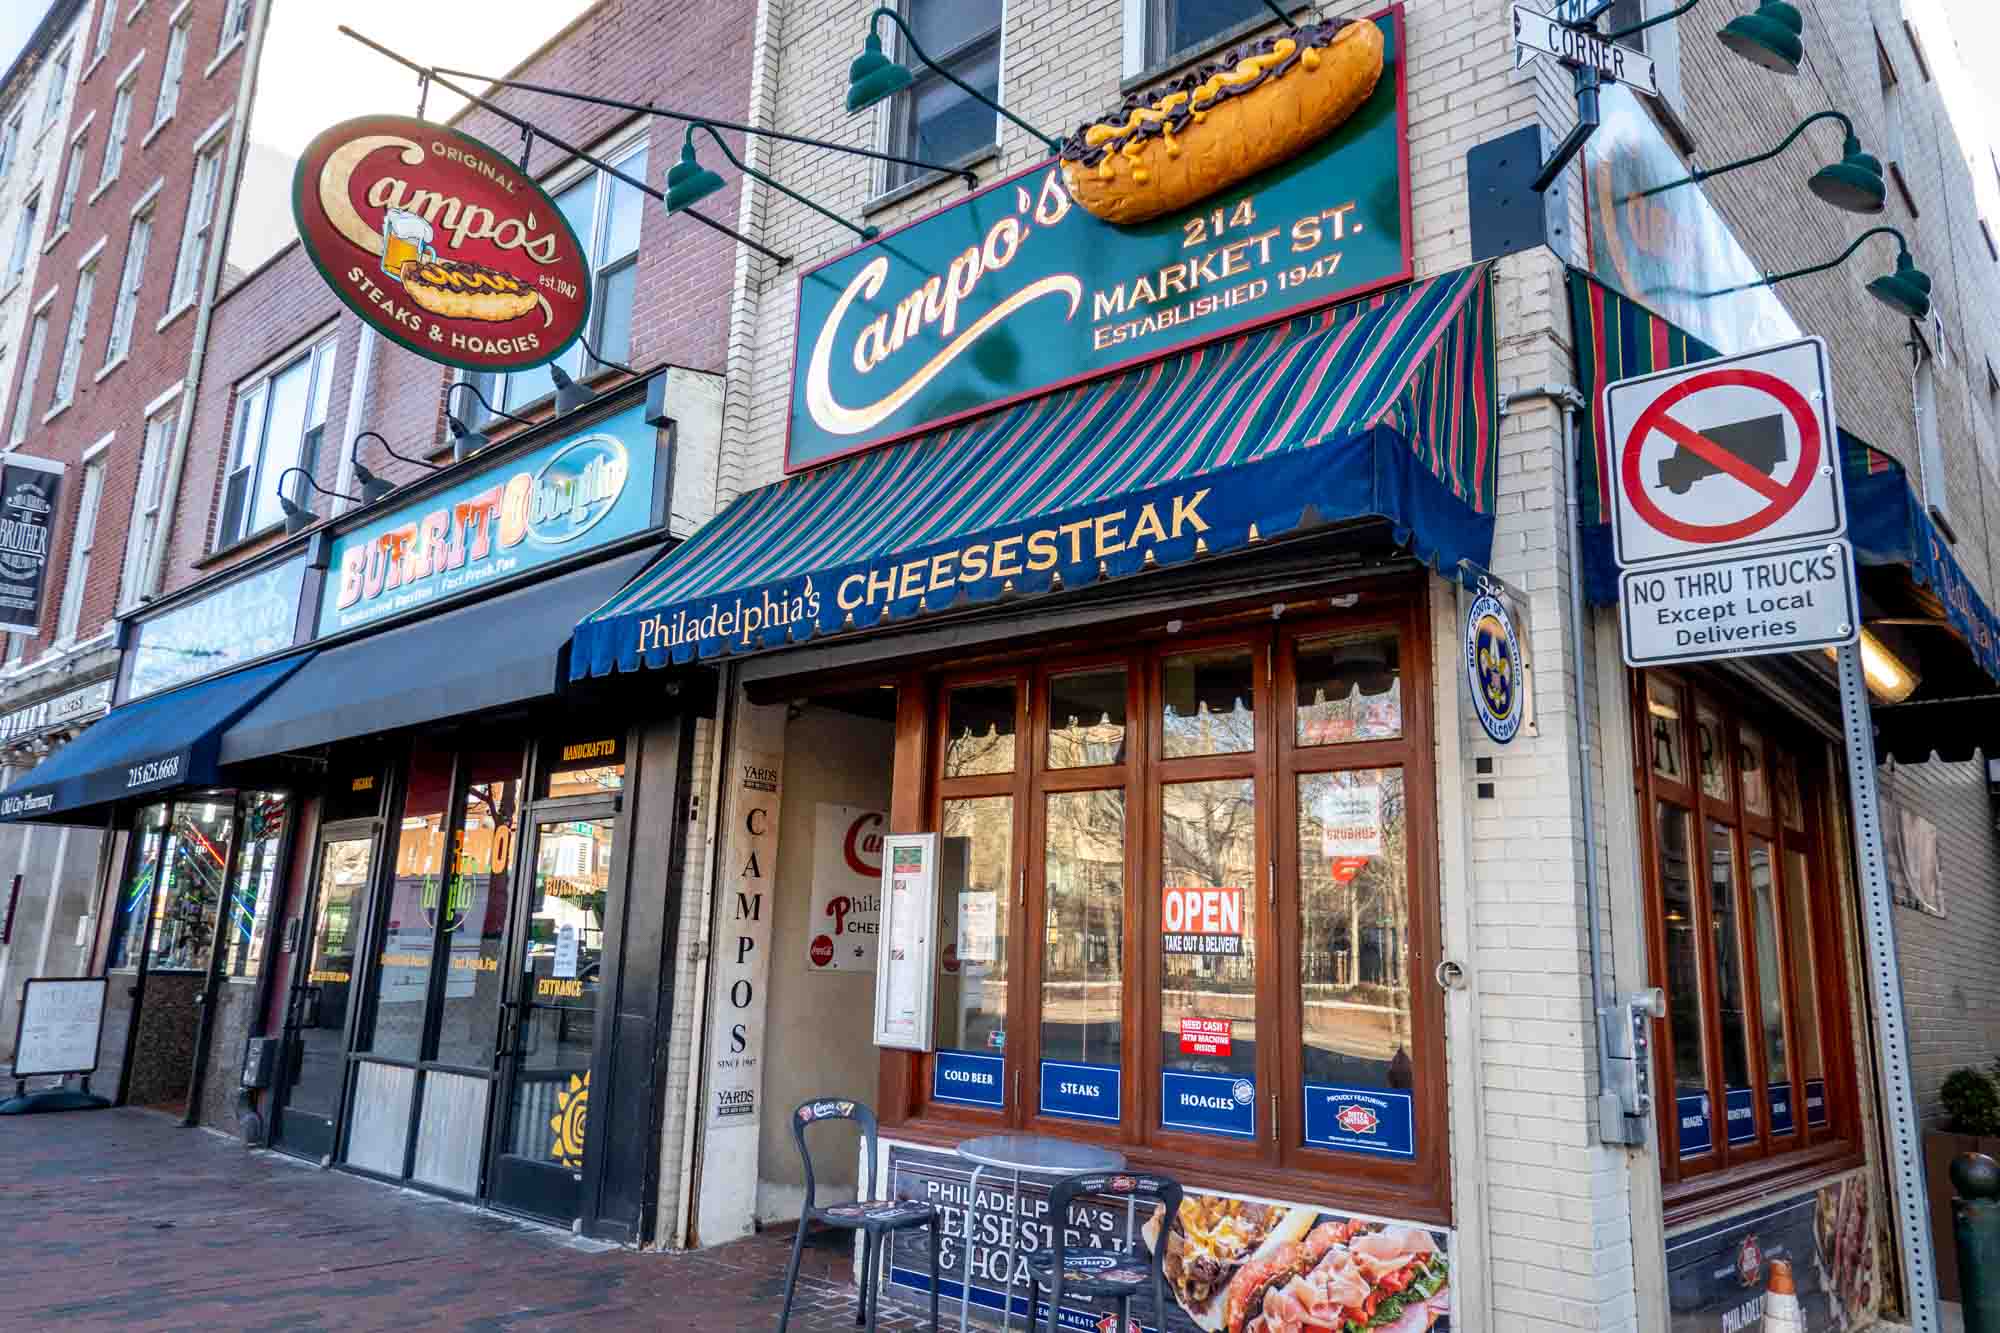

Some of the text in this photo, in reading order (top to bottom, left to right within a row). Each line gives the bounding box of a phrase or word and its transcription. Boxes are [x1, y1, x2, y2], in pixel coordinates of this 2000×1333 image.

[1548, 23, 1625, 79] CORNER
[431, 142, 516, 194] ORIGINAL
[318, 135, 563, 264] Campo's
[1183, 197, 1256, 249] 214
[1092, 201, 1365, 321] MARKET ST.
[348, 266, 539, 355] STEAKS & HOAGIES
[806, 169, 1072, 435] Campo's
[1093, 254, 1343, 350] ESTABLISHED 1947
[0, 518, 47, 554] BROTHER
[636, 487, 1213, 654] Philadelphia's CHEESESTEAK
[1633, 555, 1837, 605] NO THRU TRUCKS
[1471, 599, 1491, 631] SCOUTS
[1657, 590, 1814, 625] Except Local
[1676, 620, 1797, 646] Deliveries
[1482, 706, 1518, 738] WELCOME
[563, 738, 616, 761] HANDCRAFTED
[127, 755, 180, 788] 215.625.6668
[744, 766, 777, 782] YARDS
[1165, 890, 1240, 932] OPEN
[1165, 935, 1239, 953] TAKE OUT & DELIVERY
[538, 979, 584, 997] ENTRANCE
[1183, 1020, 1201, 1030] NEED
[1203, 1022, 1222, 1032] CASH
[1183, 1033, 1229, 1045] ATM MACHINE
[1194, 1043, 1217, 1053] INSIDE
[944, 1070, 993, 1085] COLD BEER
[1060, 1083, 1100, 1097] STEAKS
[718, 1089, 754, 1105] YARDS
[1180, 1093, 1235, 1110] HOAGIES
[1326, 1094, 1389, 1108] PROUDLY FEATURING
[928, 1181, 1113, 1231] PHILADELPIA'S
[938, 1237, 955, 1269] &
[1068, 1314, 1095, 1330] MEATS
